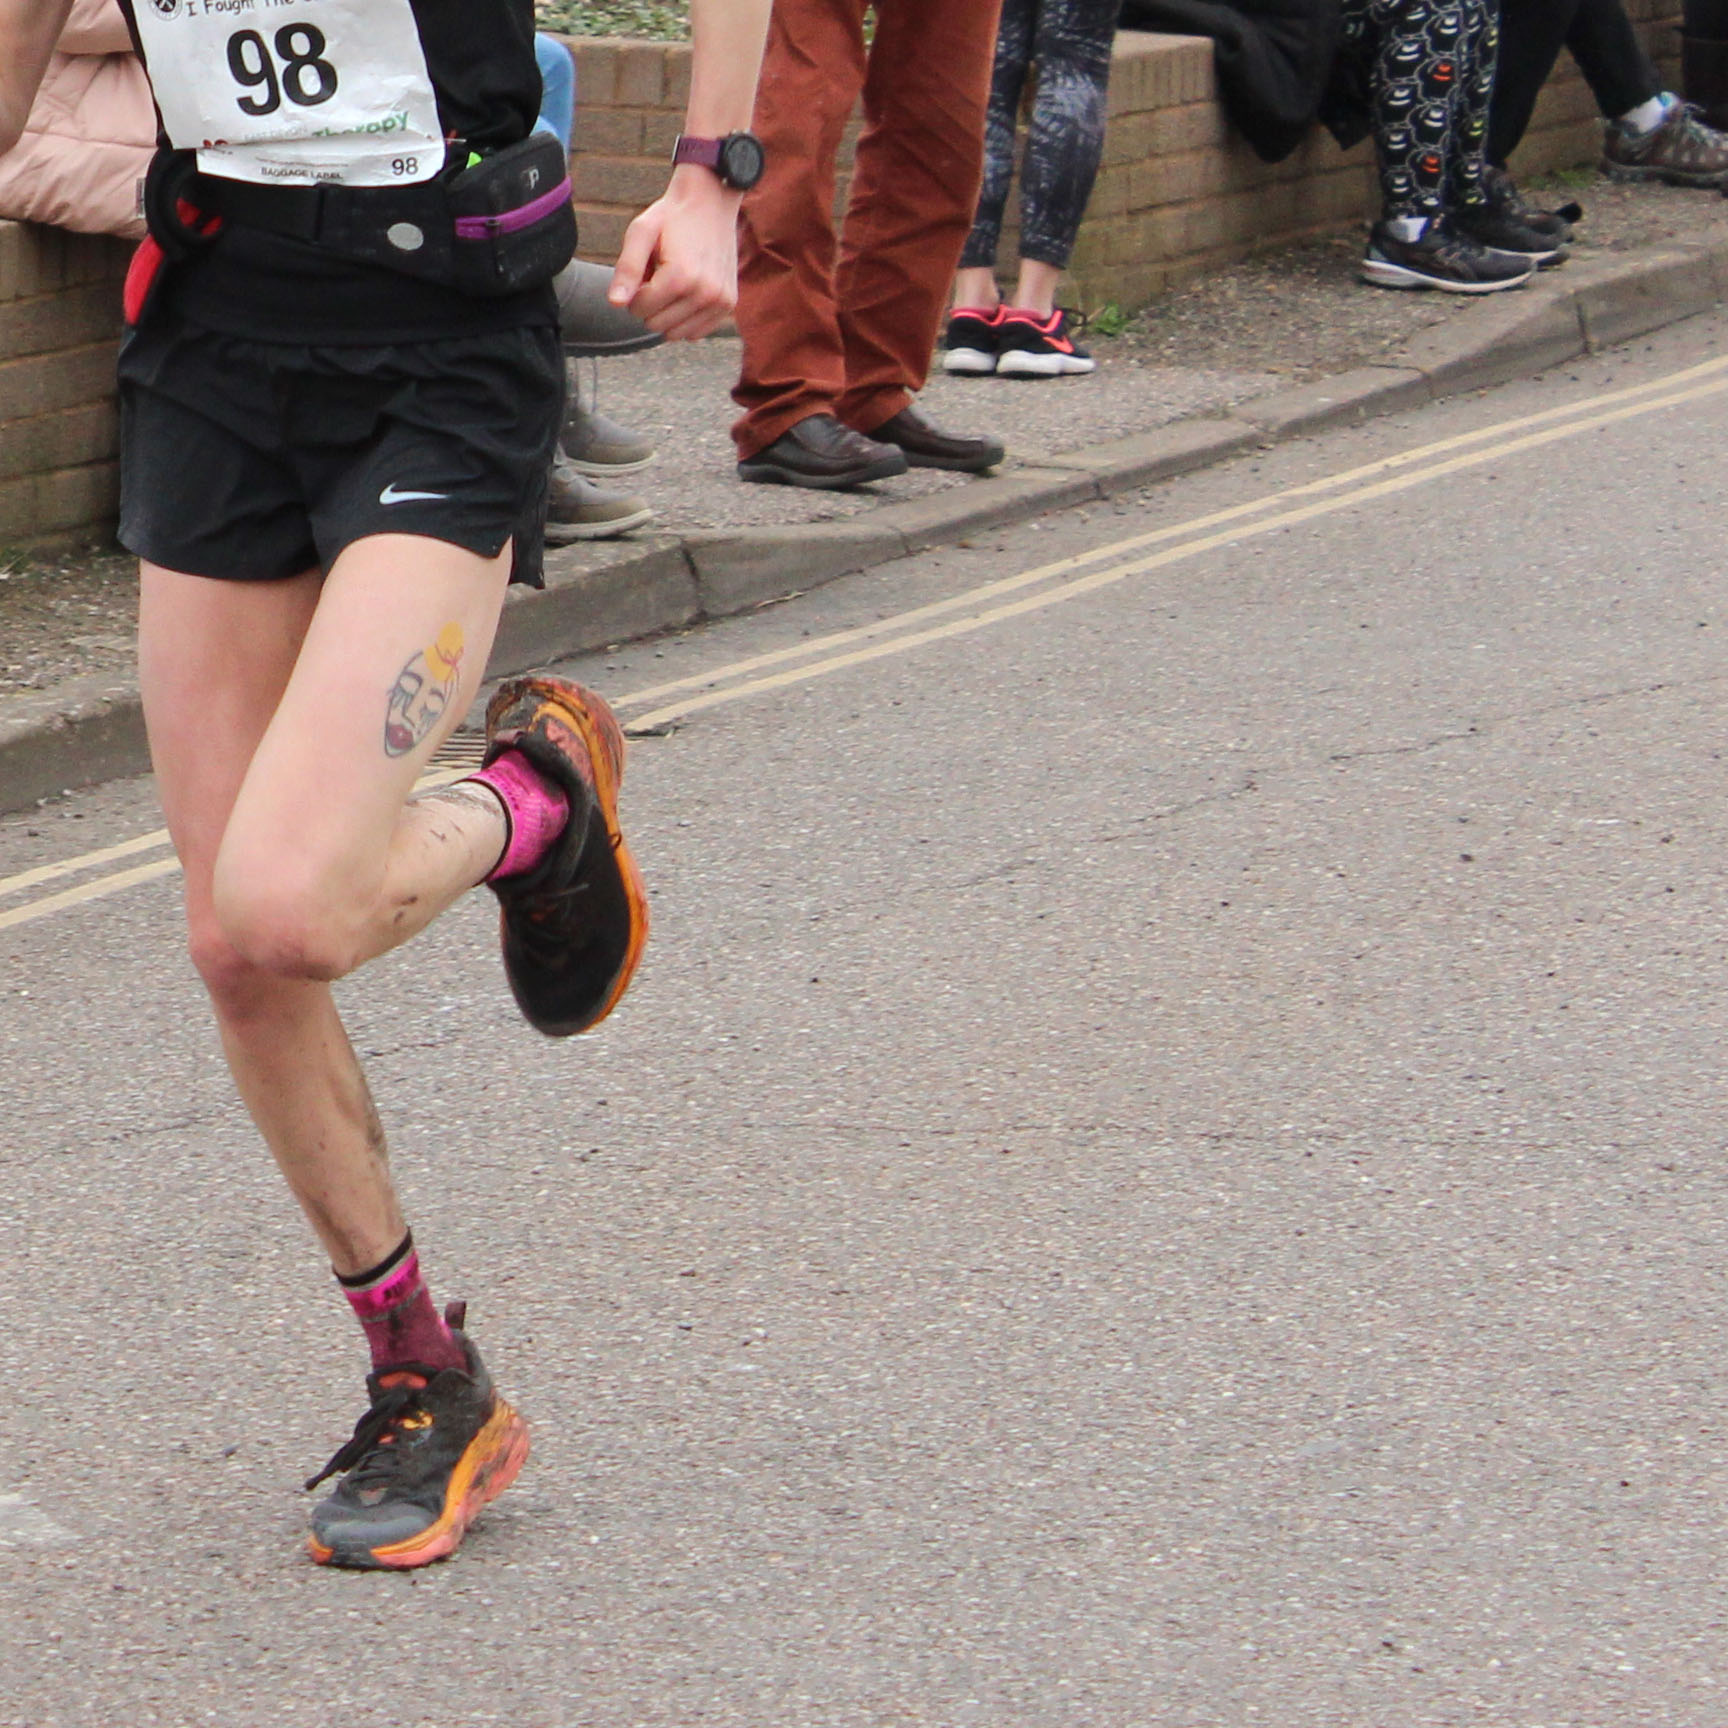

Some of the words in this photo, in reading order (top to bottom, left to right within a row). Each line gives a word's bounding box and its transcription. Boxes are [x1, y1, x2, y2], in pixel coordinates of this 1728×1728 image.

[185, 2, 196, 17] I
[226, 22, 338, 116] 98
[392, 156, 419, 177] 98
